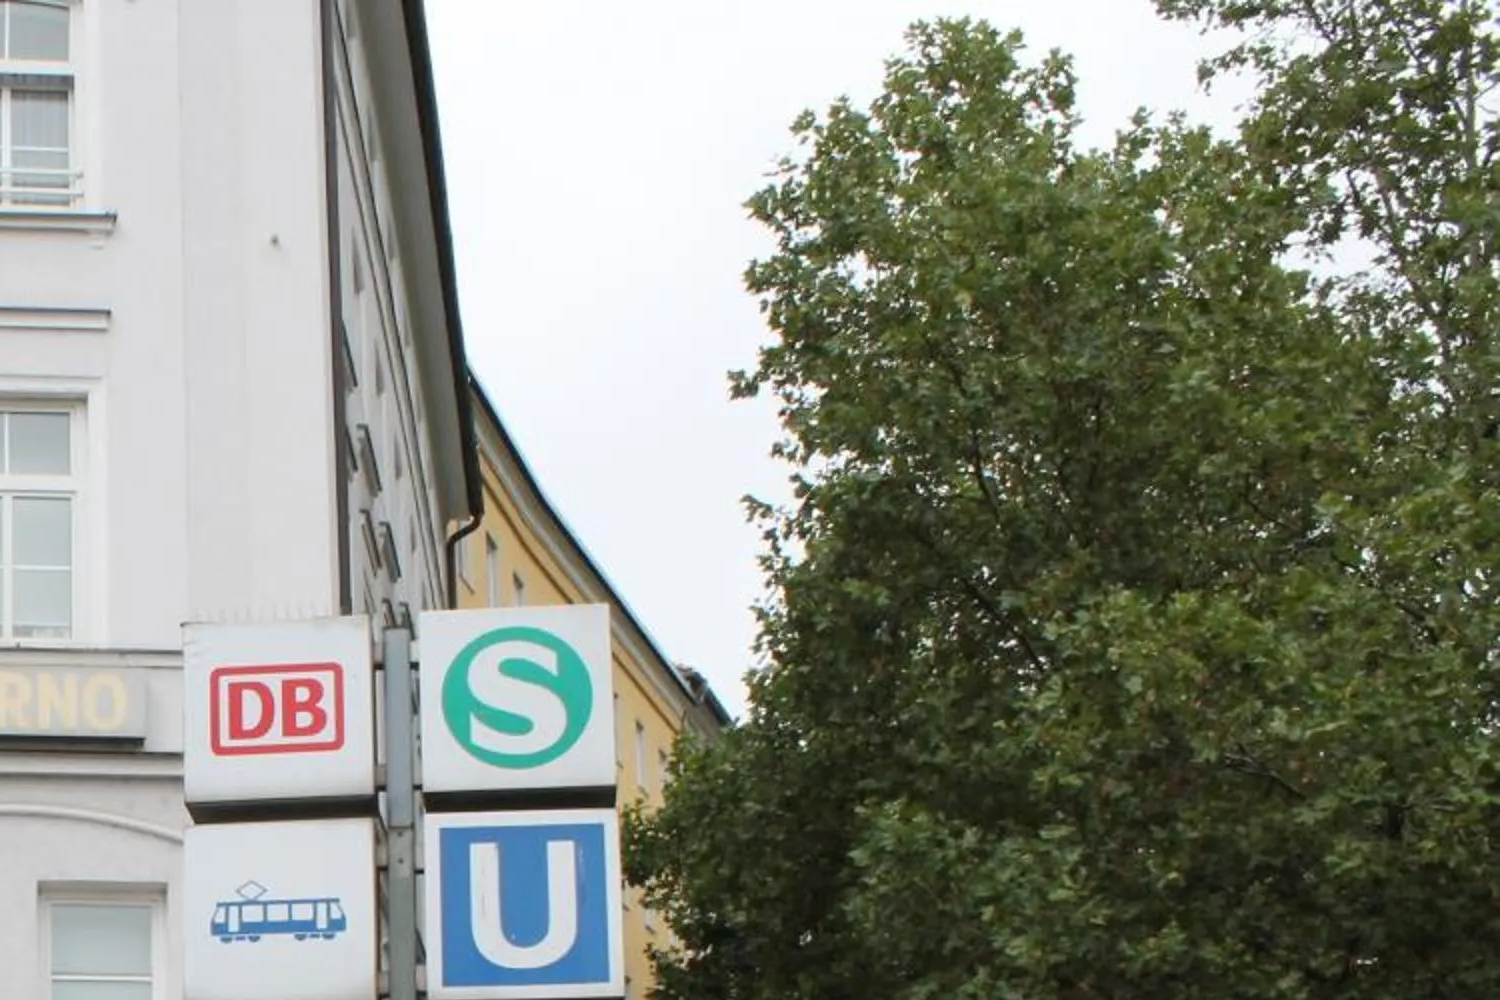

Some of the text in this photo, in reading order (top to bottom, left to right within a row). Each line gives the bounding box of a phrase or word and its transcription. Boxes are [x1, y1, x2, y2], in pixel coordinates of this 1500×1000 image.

[228, 678, 327, 741] DB
[467, 640, 568, 755] S
[469, 840, 578, 970] U
